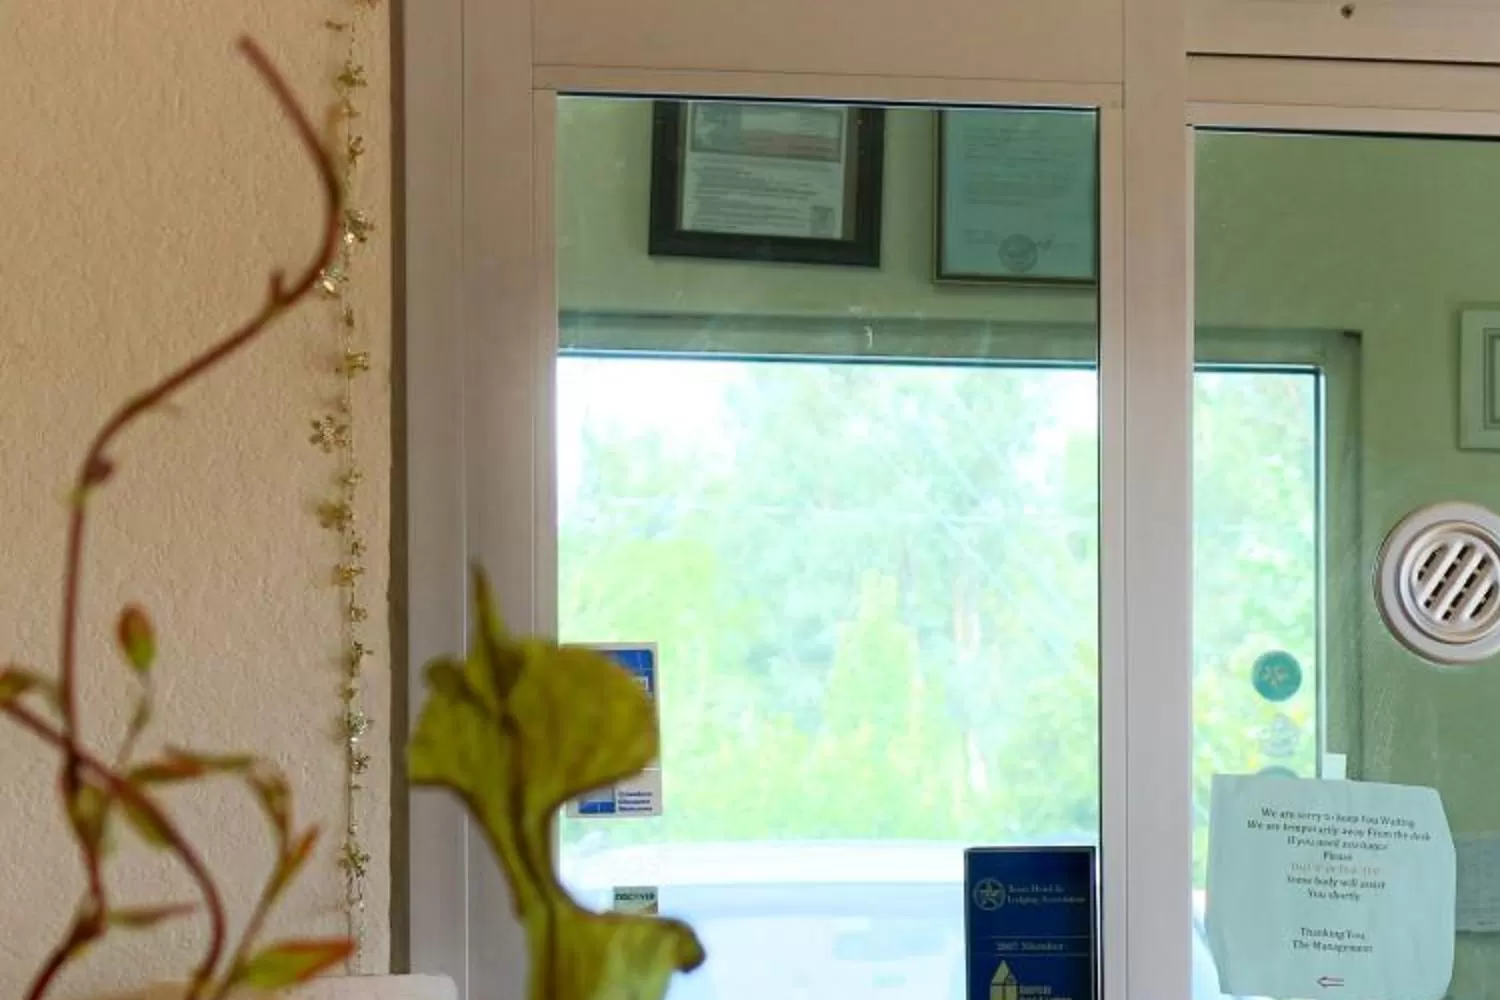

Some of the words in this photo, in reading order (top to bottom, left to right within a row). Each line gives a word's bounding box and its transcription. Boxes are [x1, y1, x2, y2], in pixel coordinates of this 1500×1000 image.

[1262, 807, 1278, 819] We
[1280, 810, 1295, 819] are
[1298, 812, 1321, 823] sorry
[1247, 819, 1263, 829] We
[1266, 823, 1280, 831] are
[1300, 926, 1345, 941] Thanking
[1292, 939, 1310, 950] The
[1313, 940, 1374, 954] Management
